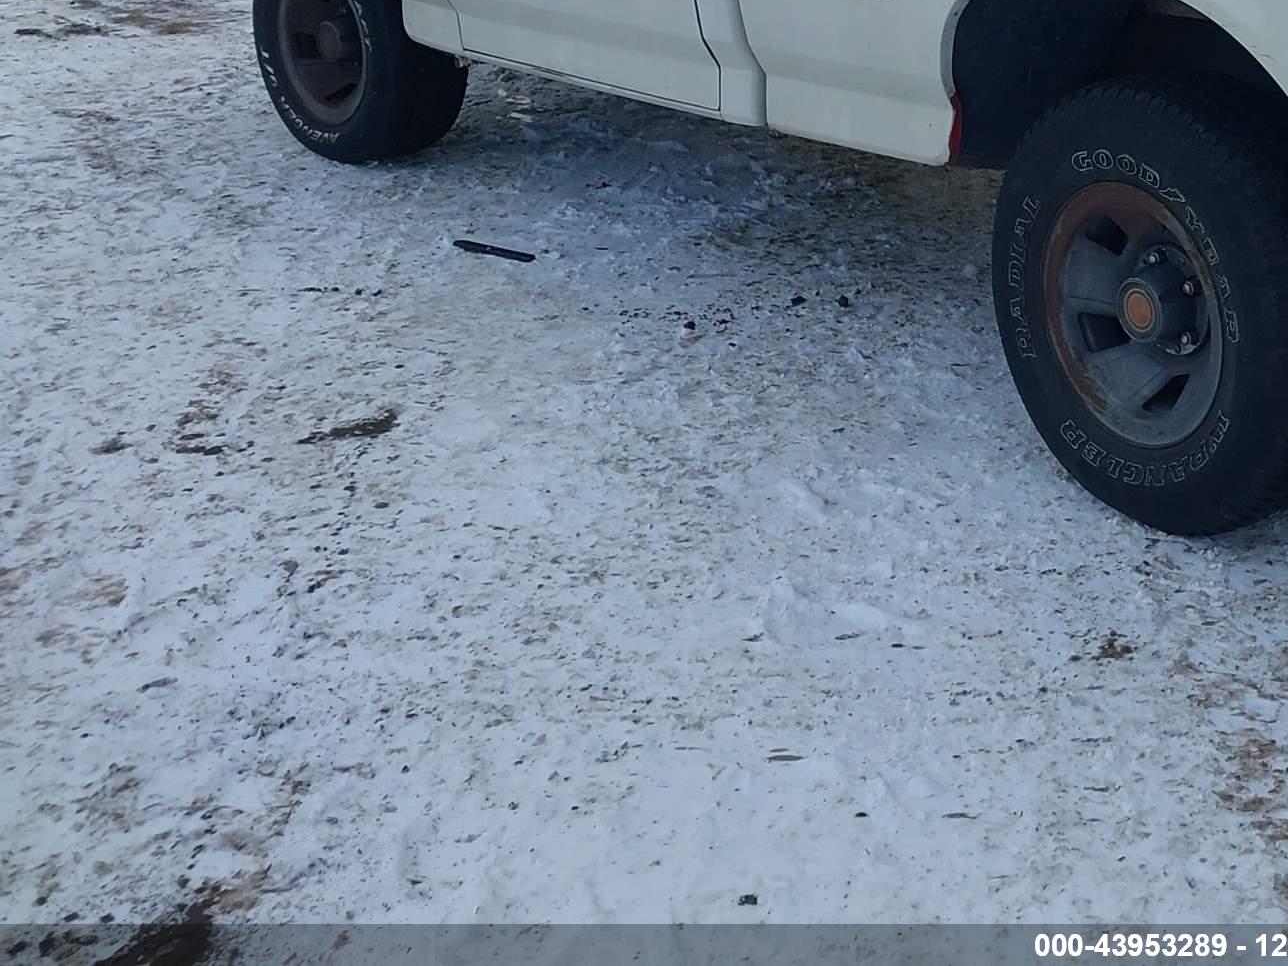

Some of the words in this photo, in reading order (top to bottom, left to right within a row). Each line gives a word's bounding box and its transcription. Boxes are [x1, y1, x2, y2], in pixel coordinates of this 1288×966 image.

[1006, 195, 1042, 363] RADIAL
[1071, 148, 1241, 344] GOODYEAR
[1058, 409, 1232, 488] WRANGLER
